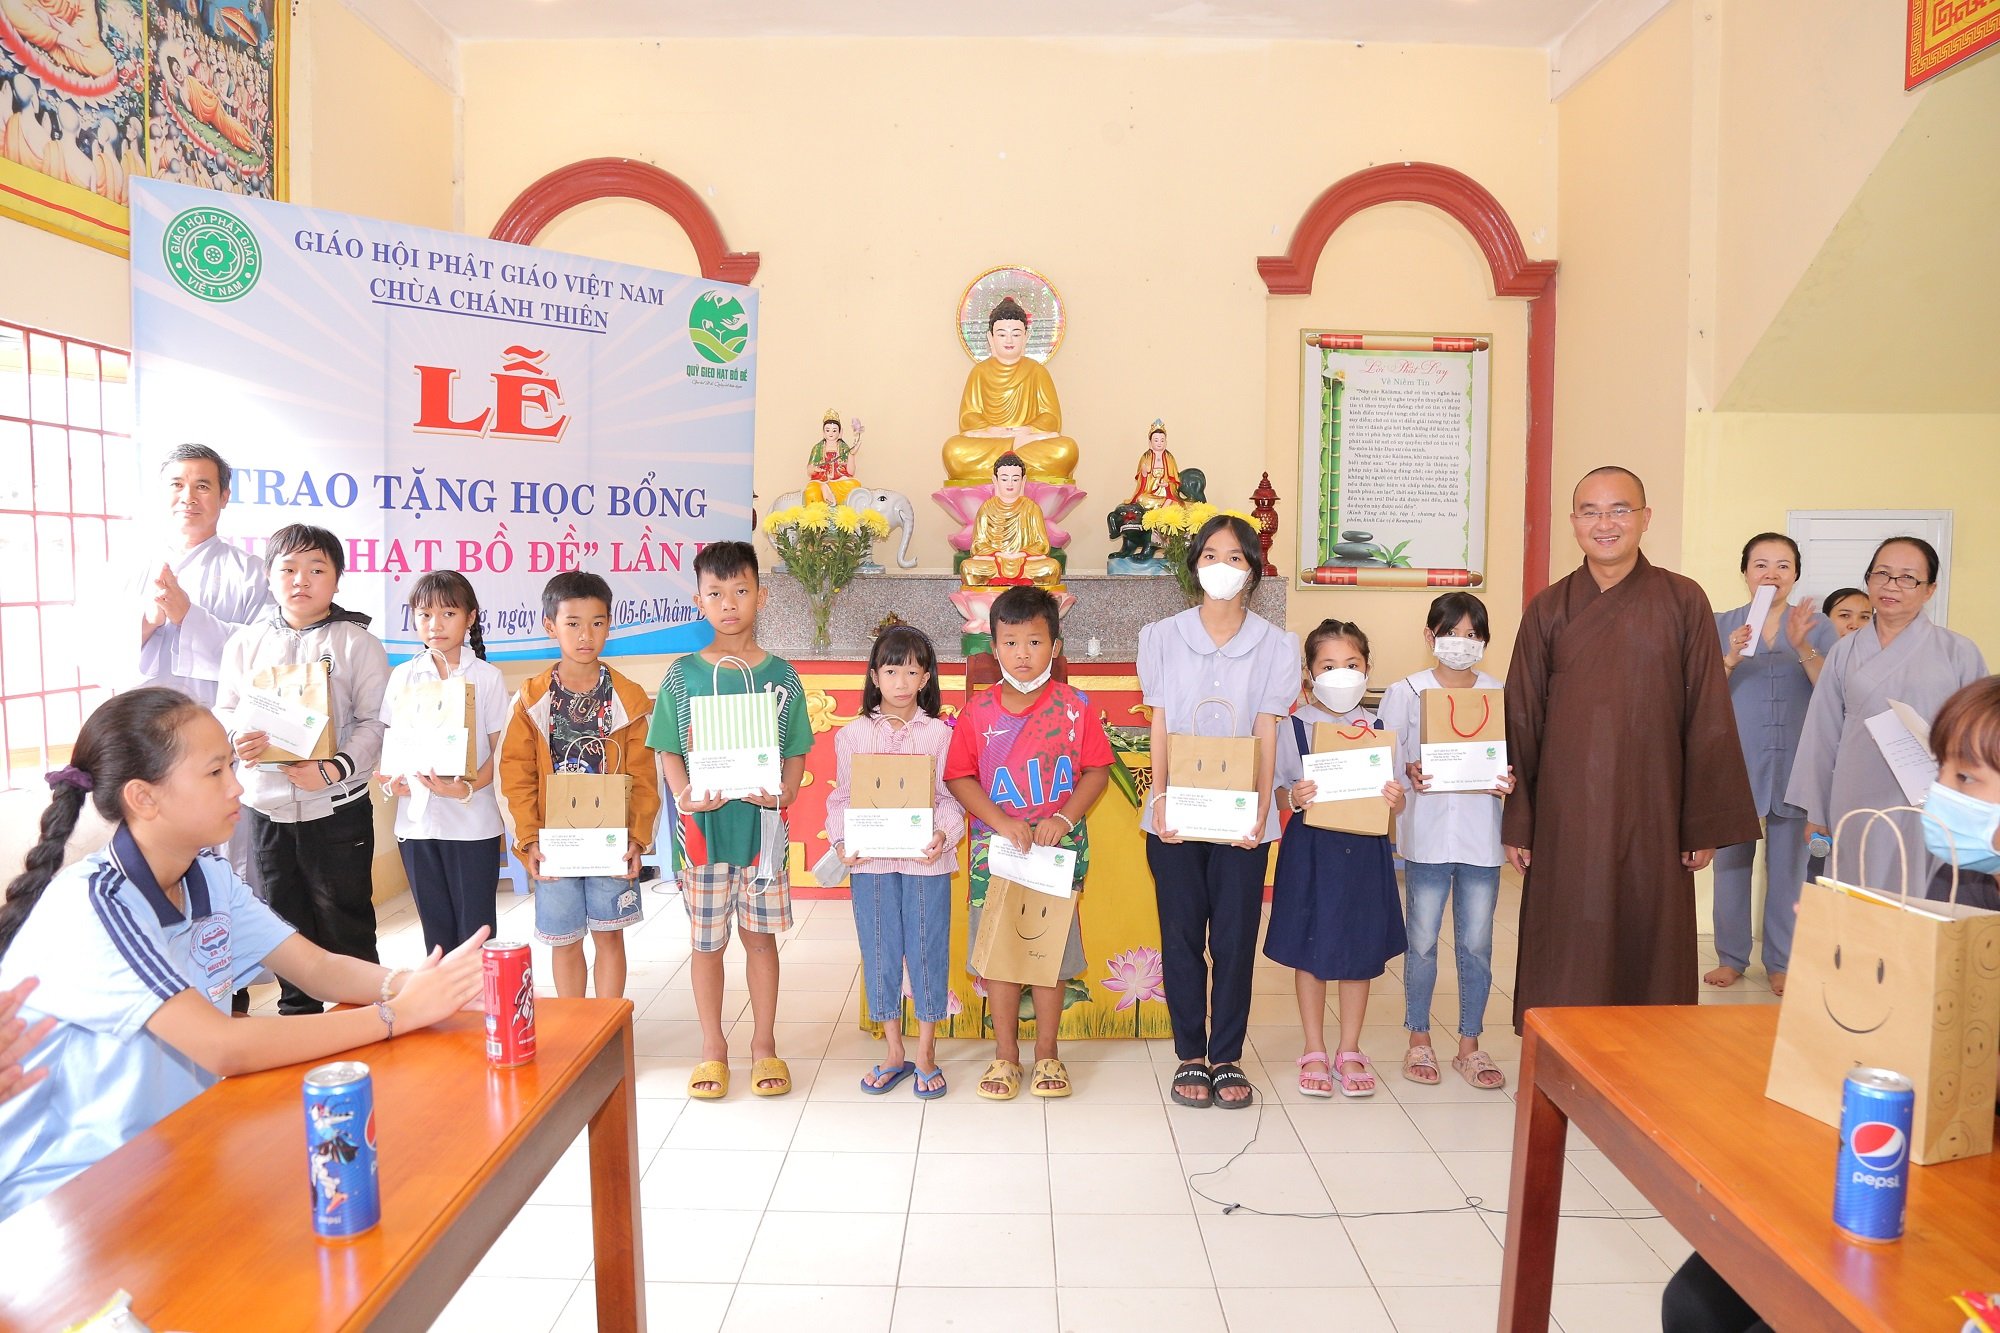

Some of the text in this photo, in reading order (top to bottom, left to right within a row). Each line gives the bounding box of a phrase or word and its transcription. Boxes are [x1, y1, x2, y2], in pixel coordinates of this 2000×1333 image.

[171, 212, 256, 266] GIÁO HỘI PHẬT GIÁO
[187, 277, 243, 296] VIỆT NAM
[294, 230, 664, 305] GIÁO HỘI PHẬT GIÁO VIỆT NAM
[370, 278, 608, 328] CHÙA CHÁNH THIÊN
[413, 345, 570, 440] LỄ
[229, 466, 707, 523] TRAO TẶNG HỌC BỔNG
[345, 522, 683, 582] HẠT BỒ ĐỀ” LẦN
[497, 602, 536, 635] ngày
[990, 755, 1075, 809] AIA
[1852, 1171, 1901, 1189] pepsi
